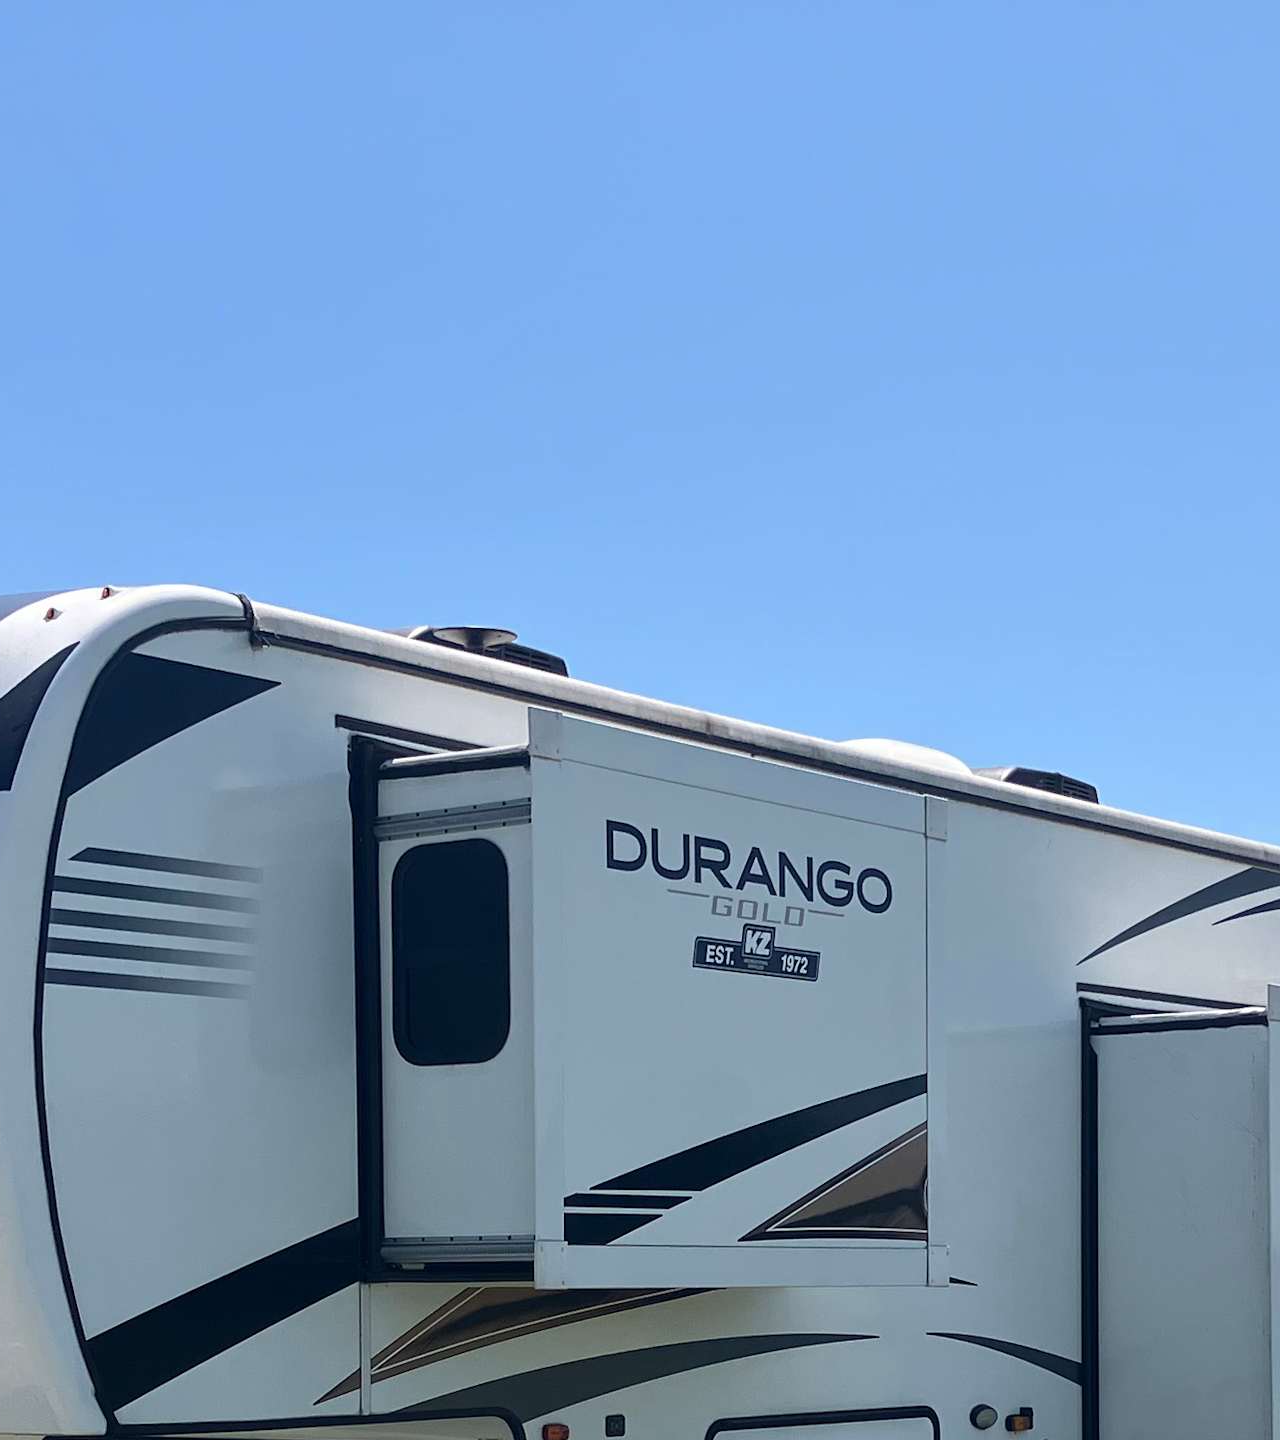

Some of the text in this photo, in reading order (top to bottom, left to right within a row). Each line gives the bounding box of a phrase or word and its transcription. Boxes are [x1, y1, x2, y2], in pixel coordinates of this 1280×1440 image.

[606, 819, 892, 914] DURANGO
[711, 895, 805, 927] GOLD
[744, 929, 772, 956] KZ
[705, 944, 735, 966] EST.
[780, 953, 809, 974] 1972
